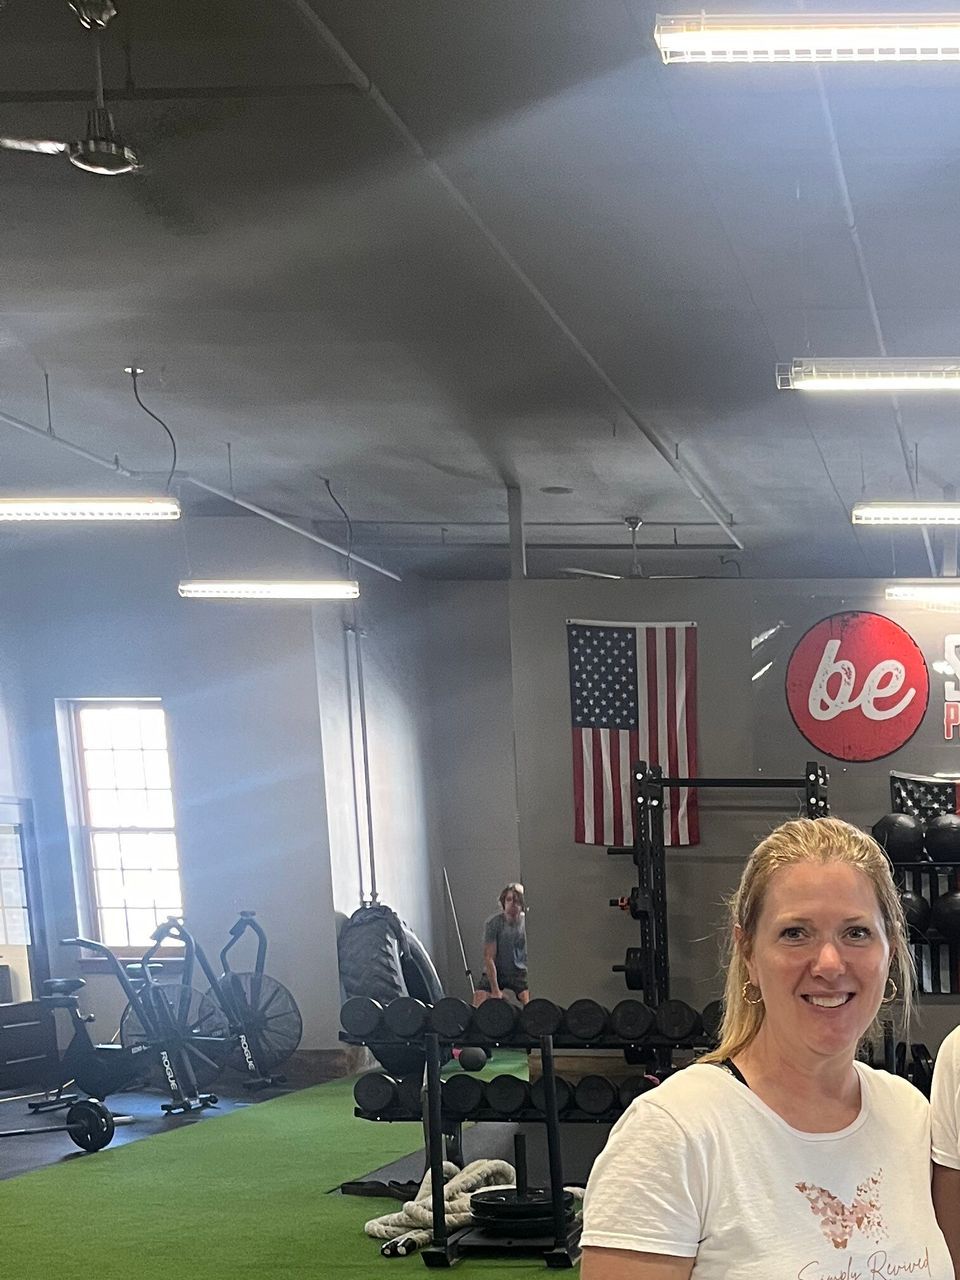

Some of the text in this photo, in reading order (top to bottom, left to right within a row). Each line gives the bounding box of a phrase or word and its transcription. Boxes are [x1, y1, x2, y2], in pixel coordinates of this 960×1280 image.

[808, 639, 916, 721] be
[160, 1051, 178, 1090] ROGUE
[239, 1034, 256, 1071] ROGUE
